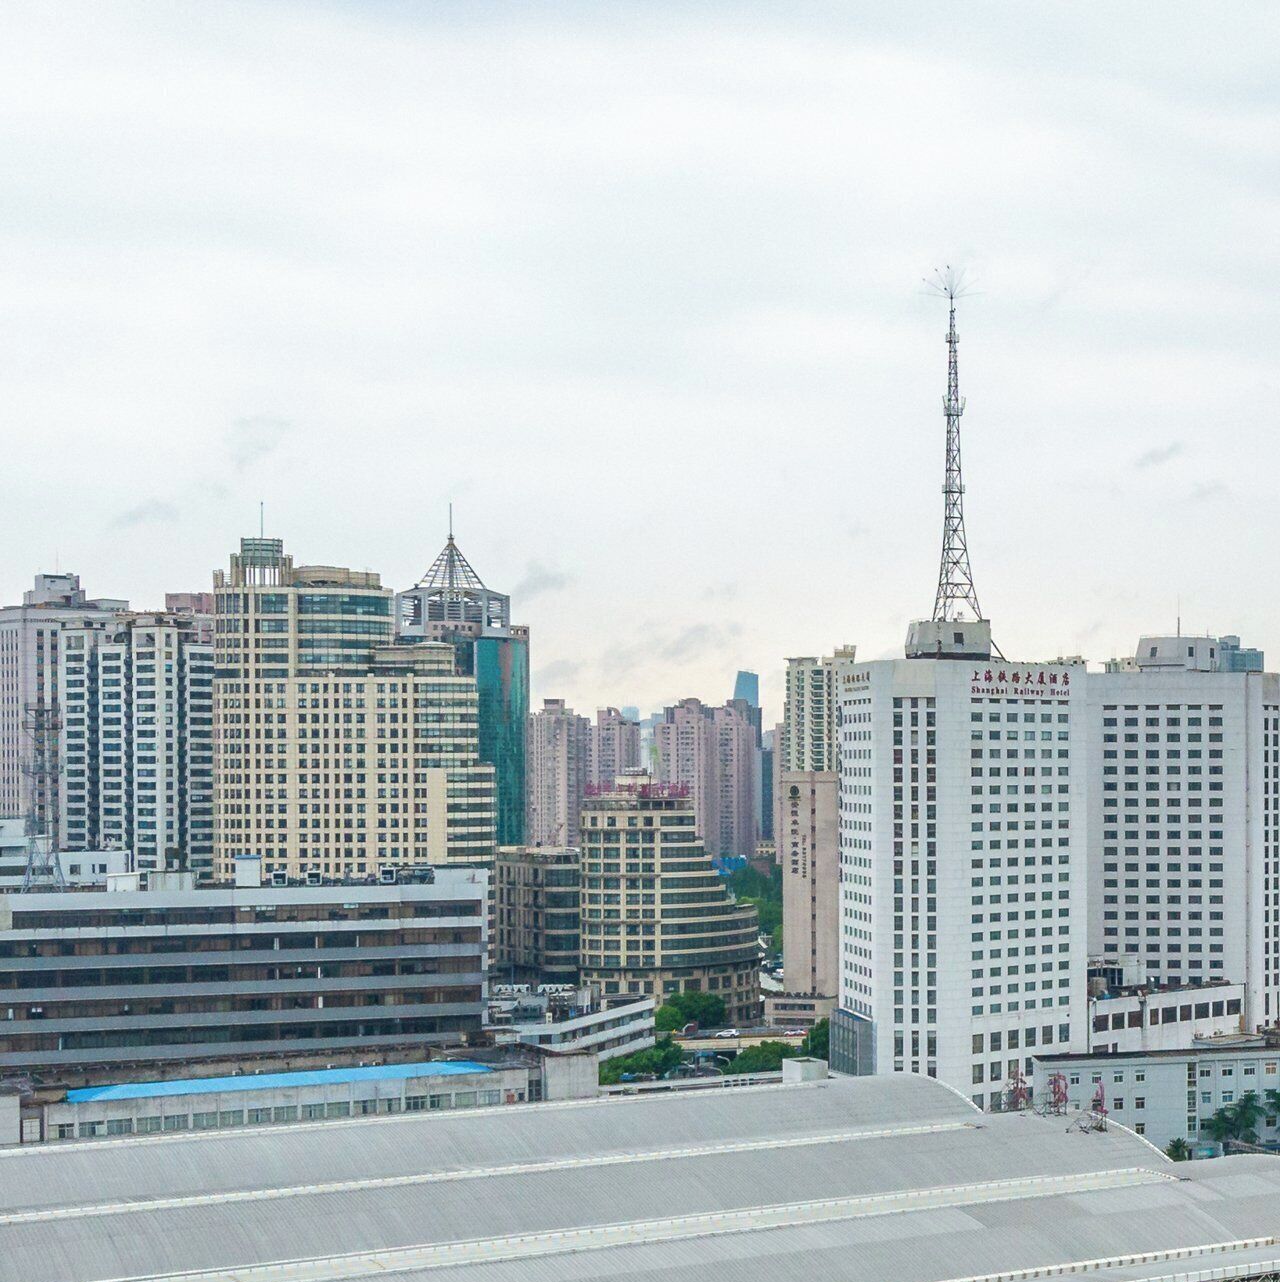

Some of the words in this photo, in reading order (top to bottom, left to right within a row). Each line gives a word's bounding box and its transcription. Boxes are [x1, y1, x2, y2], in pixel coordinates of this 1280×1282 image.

[971, 686, 1008, 695] Shanghai
[1014, 688, 1044, 697] Railway
[1050, 689, 1070, 697] Hotel
